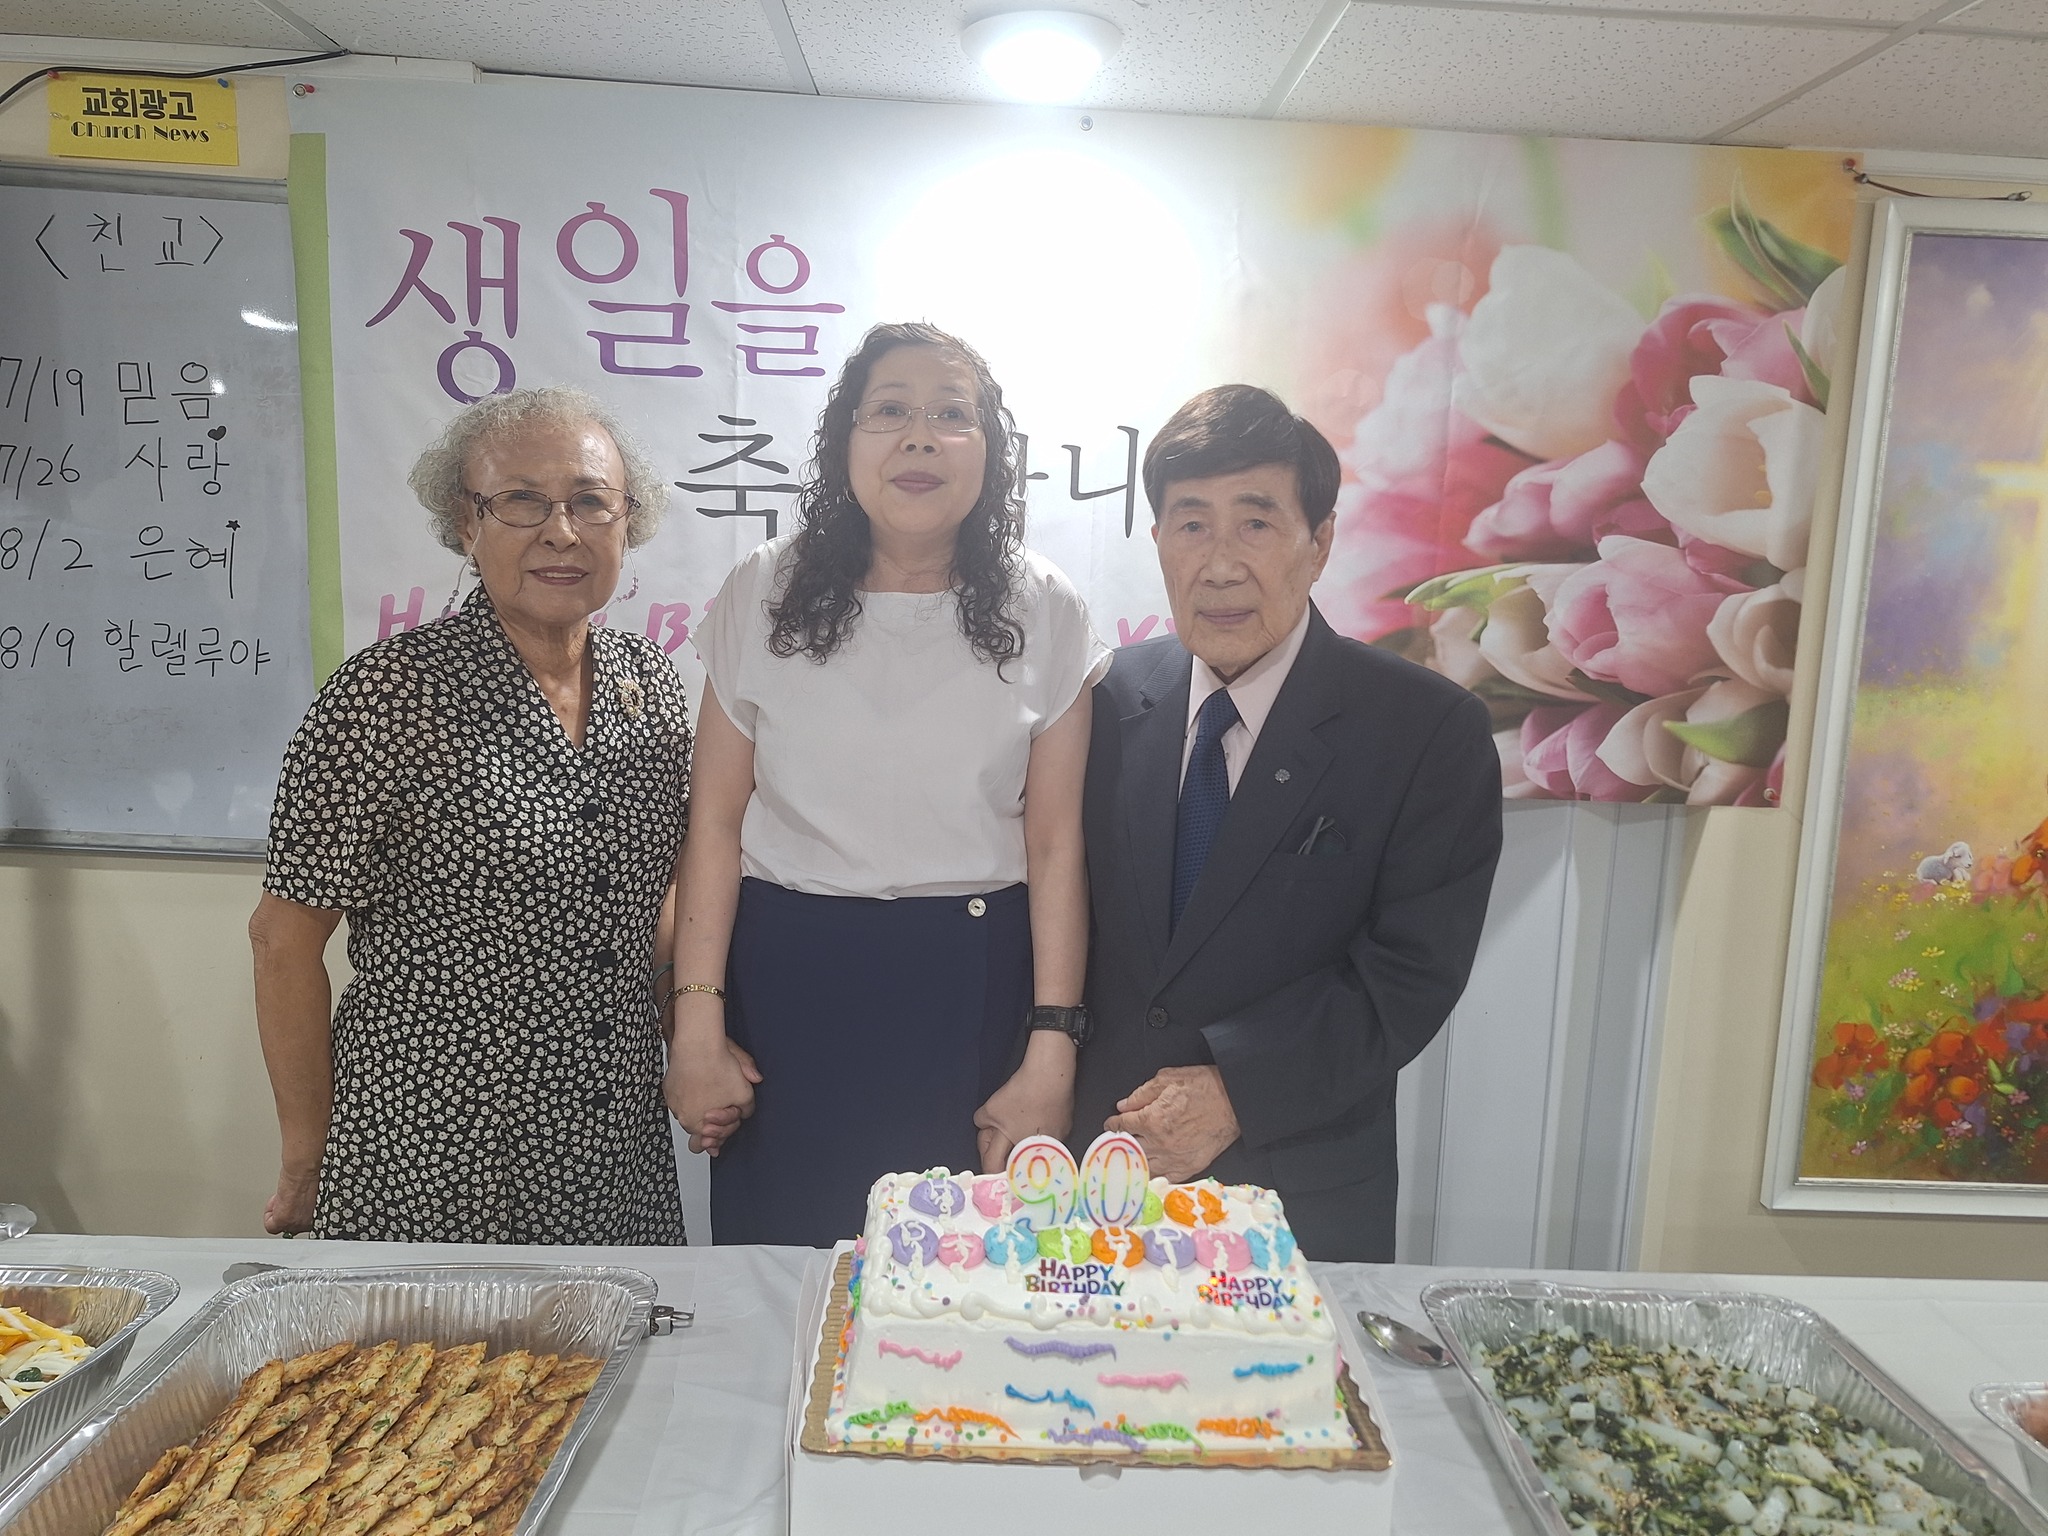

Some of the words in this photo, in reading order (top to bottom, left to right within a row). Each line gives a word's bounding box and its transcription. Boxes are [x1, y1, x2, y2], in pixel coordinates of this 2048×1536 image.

[71, 121, 147, 140] Church
[153, 125, 210, 143] News
[82, 87, 197, 120] 교회광고
[366, 188, 846, 404] 생일을
[0, 357, 84, 417] 7/19
[118, 361, 217, 425] 믿음
[0, 444, 80, 501] 7/26
[125, 436, 230, 502] 사랑
[0, 519, 93, 580] 8/2
[130, 525, 236, 599] 은혜
[0, 622, 75, 669] 8/9
[104, 619, 271, 677] 할렐루야
[1007, 1132, 1149, 1232] 90
[1024, 1274, 1124, 1296] BIRTHDAY
[1038, 1258, 1113, 1281] HAPPY
[1209, 1270, 1282, 1293] HAPPY
